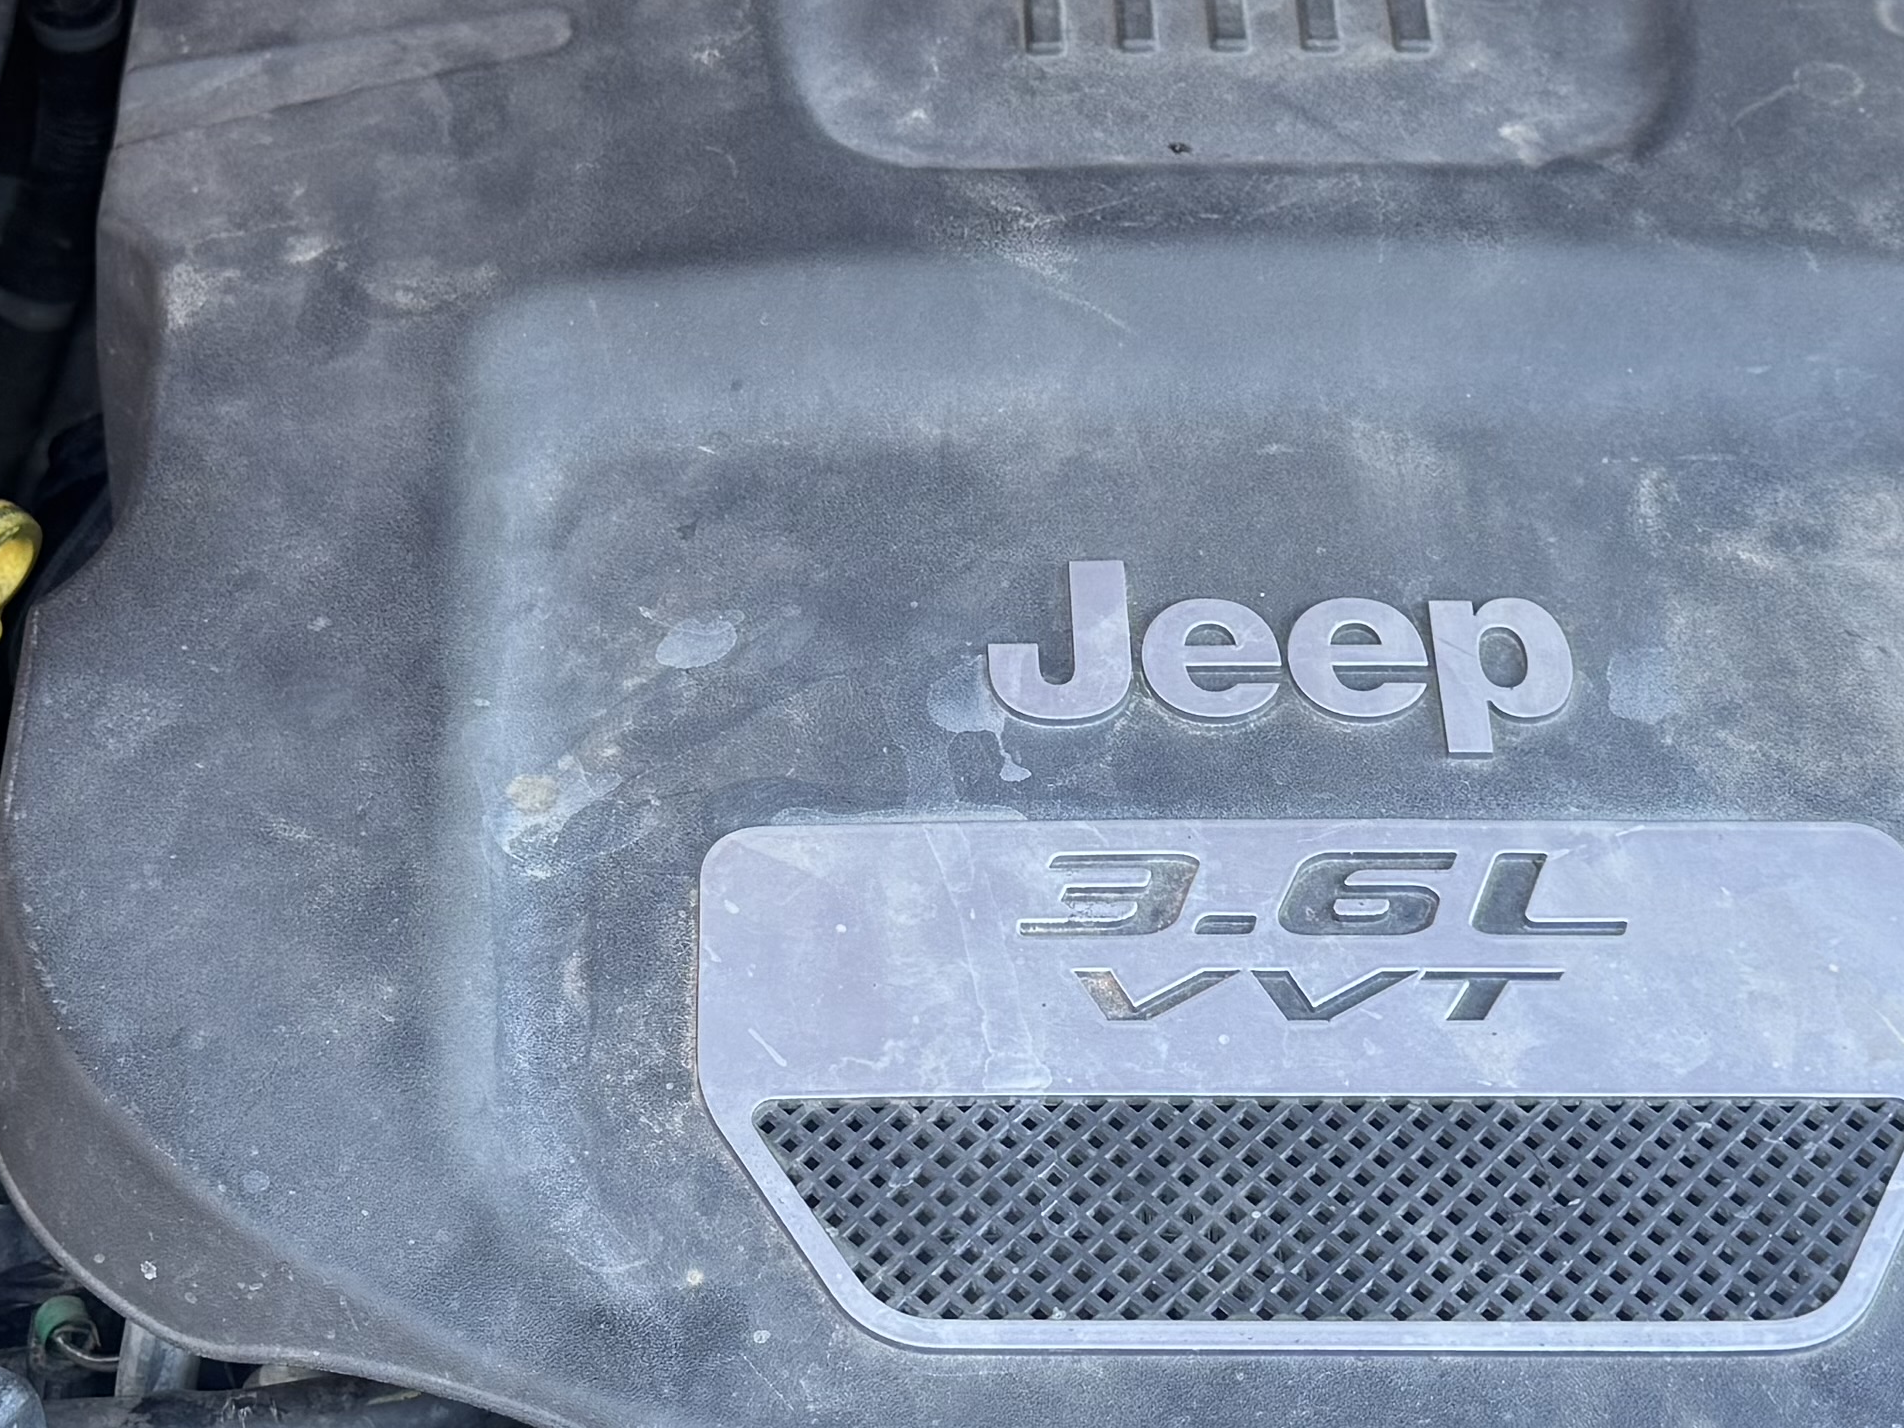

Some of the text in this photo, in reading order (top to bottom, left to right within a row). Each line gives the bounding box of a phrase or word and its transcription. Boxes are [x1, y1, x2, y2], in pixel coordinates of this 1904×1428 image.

[986, 559, 1575, 759] Jeep
[1017, 849, 1629, 937] 3.6L
[1072, 966, 1567, 1022] VVT
